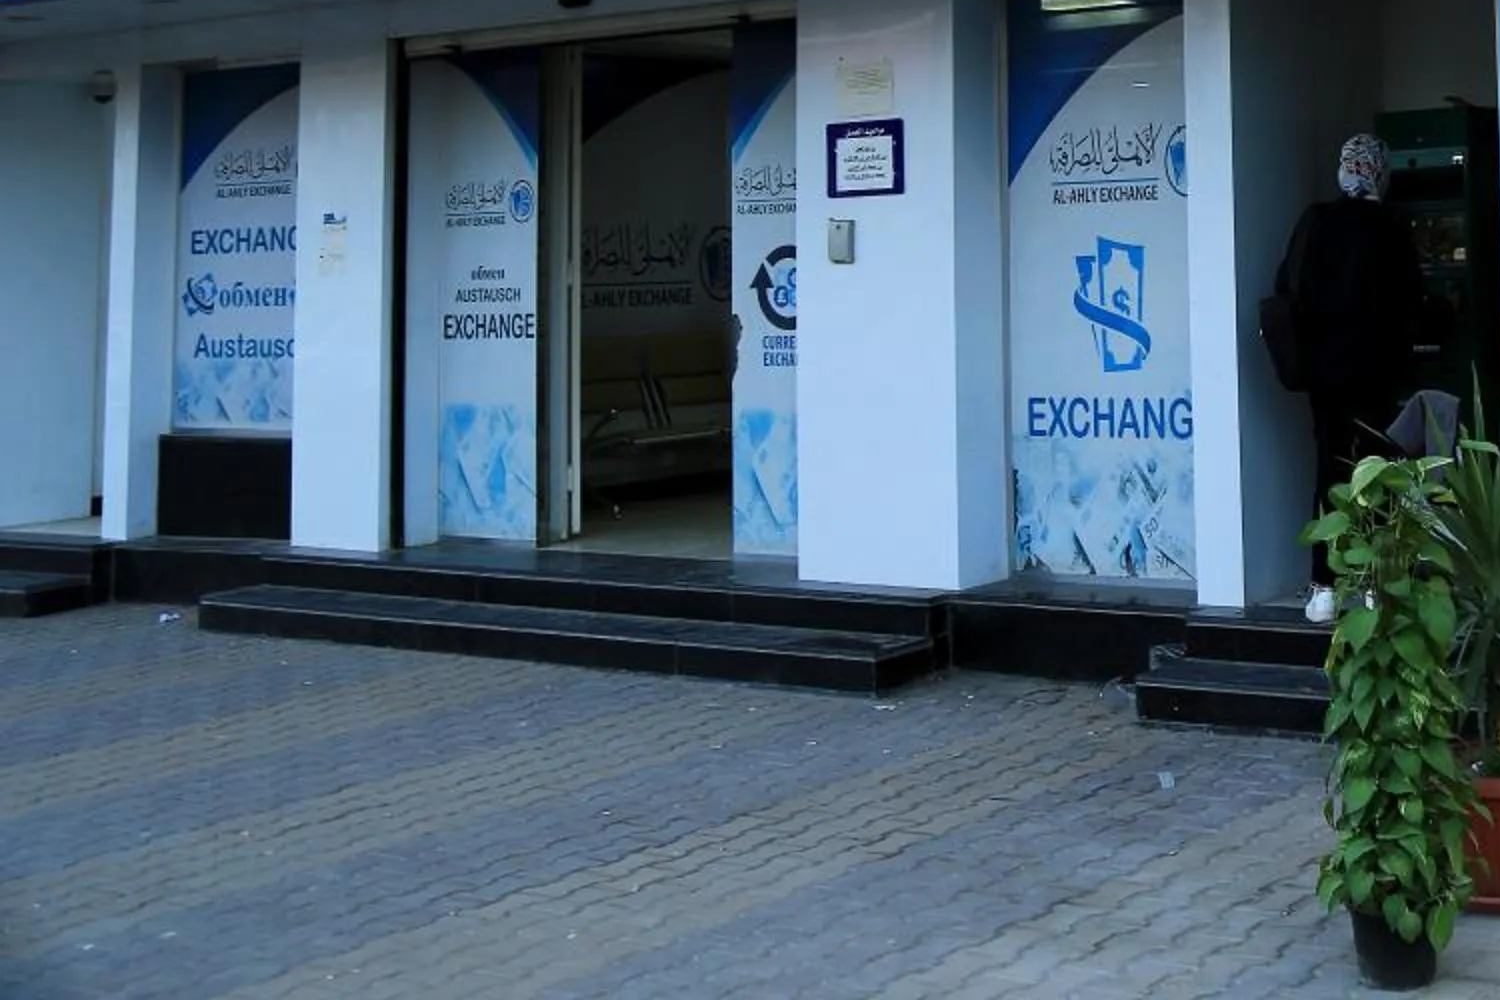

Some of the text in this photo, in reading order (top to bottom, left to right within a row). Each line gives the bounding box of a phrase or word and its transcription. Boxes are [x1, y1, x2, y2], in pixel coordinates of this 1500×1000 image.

[1053, 185, 1159, 204] AL-AHLY EXCHANGE
[455, 288, 521, 303] AUSTAUSCH
[444, 313, 535, 340] EXCHANGE
[1027, 397, 1193, 439] EXCHANG
